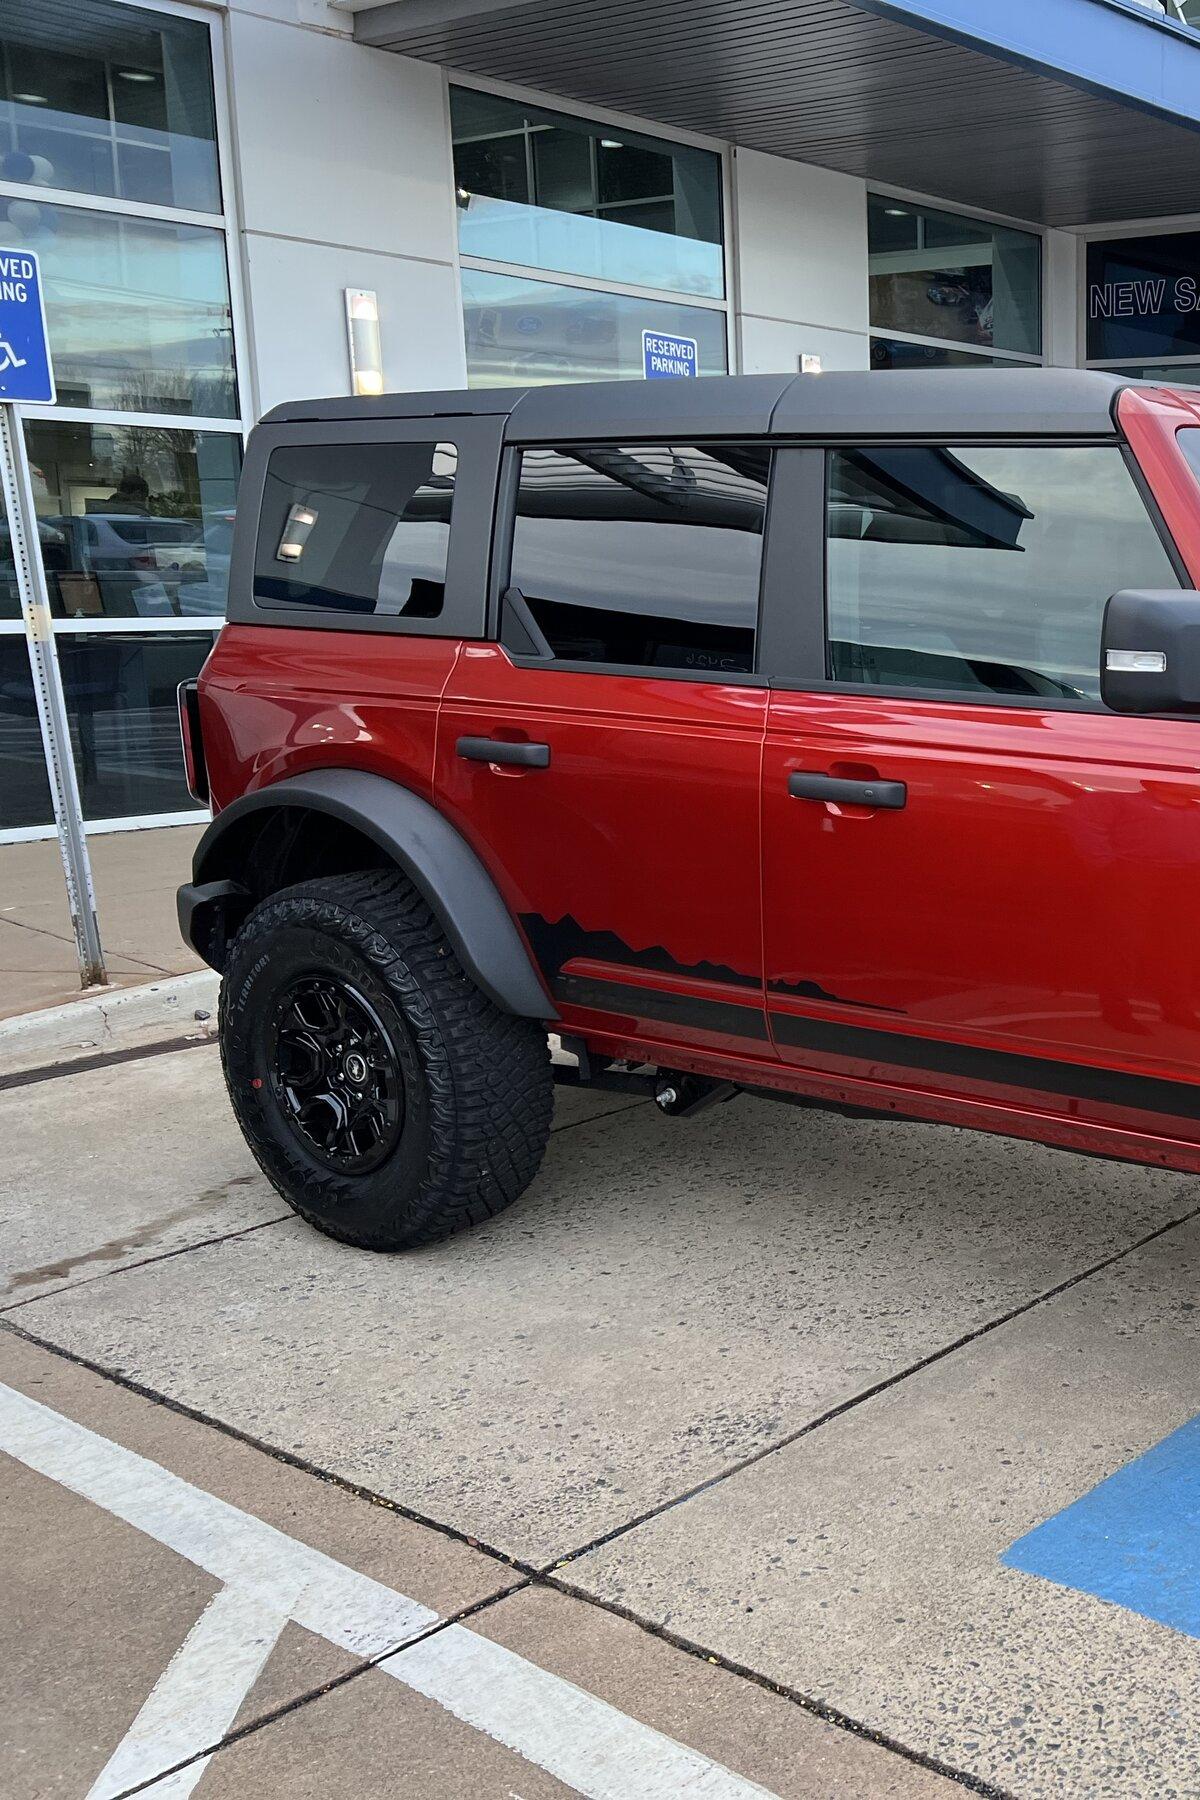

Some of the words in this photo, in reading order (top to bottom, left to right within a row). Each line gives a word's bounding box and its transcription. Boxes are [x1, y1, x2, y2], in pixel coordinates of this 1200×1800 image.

[1090, 278, 1167, 319] NEW
[645, 337, 694, 360] RESERVED
[651, 355, 690, 377] PARKING
